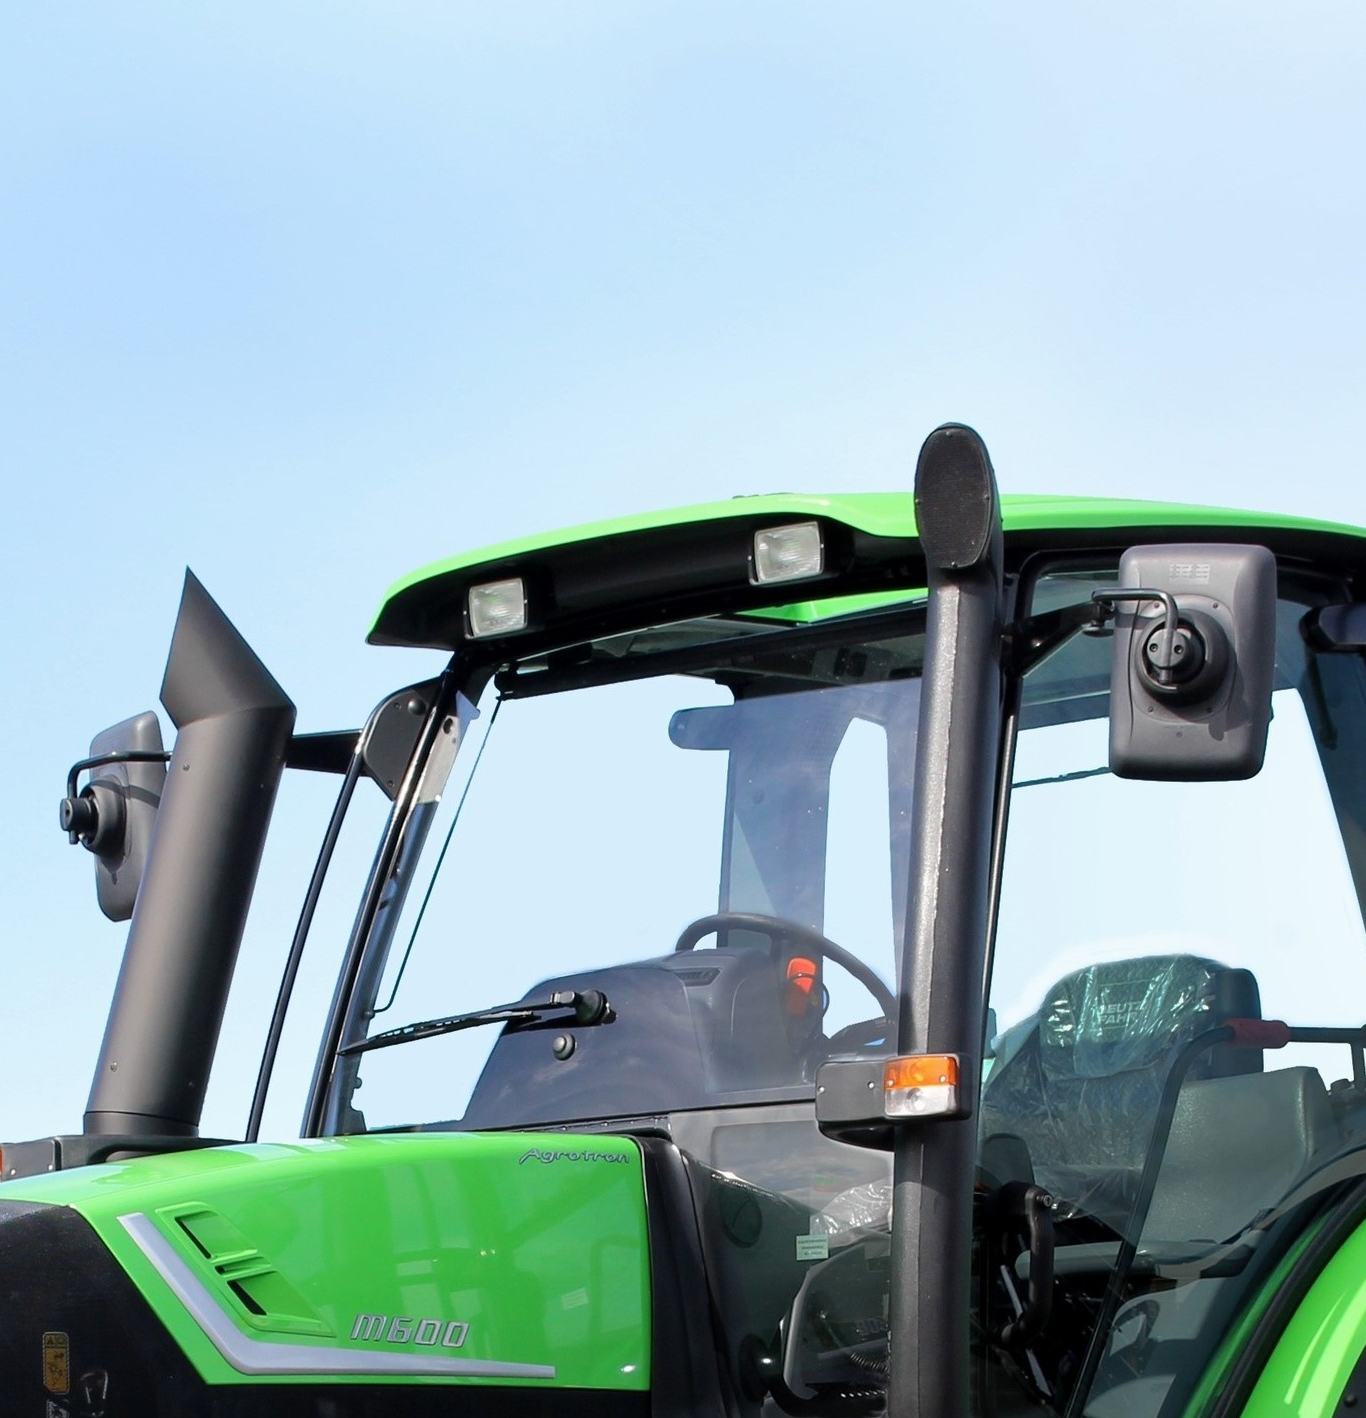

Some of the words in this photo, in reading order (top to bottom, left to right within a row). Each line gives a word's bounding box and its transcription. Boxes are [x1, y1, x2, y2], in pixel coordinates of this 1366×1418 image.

[1099, 1001, 1146, 1014] EUTZ
[519, 1147, 630, 1165] Agrotron
[350, 1314, 469, 1348] M600
